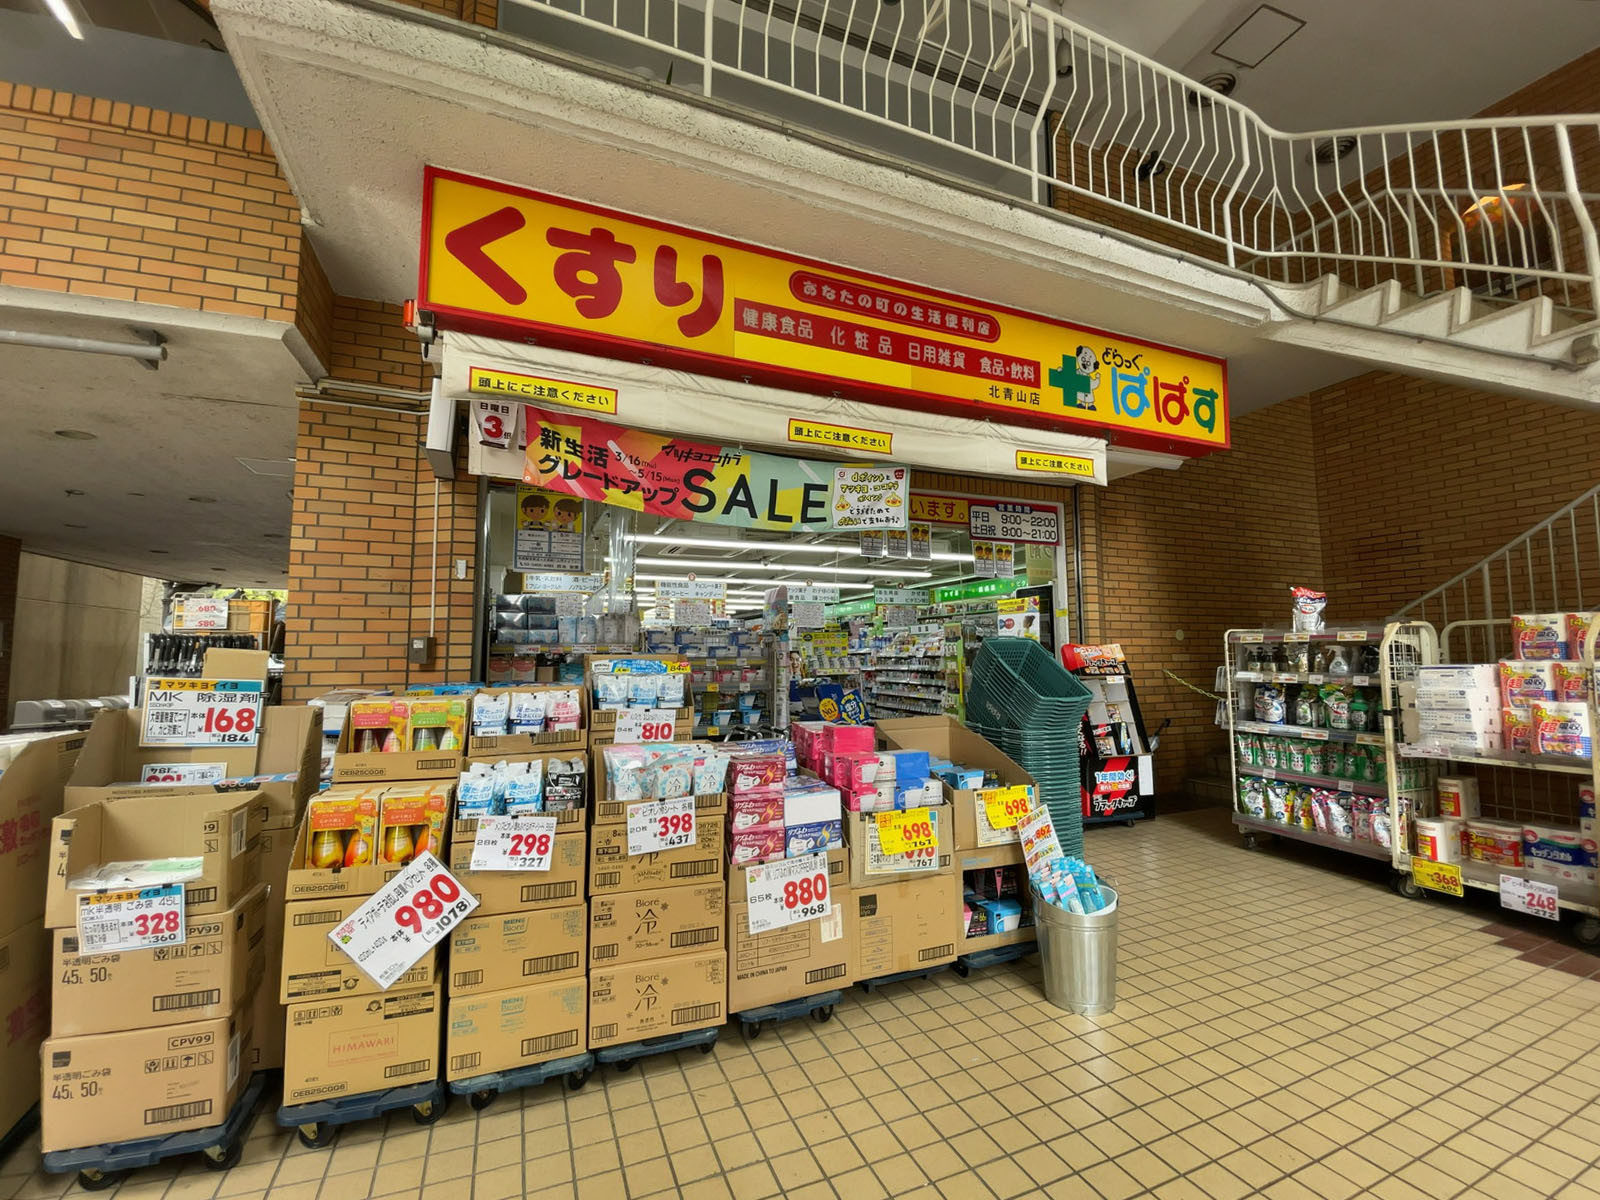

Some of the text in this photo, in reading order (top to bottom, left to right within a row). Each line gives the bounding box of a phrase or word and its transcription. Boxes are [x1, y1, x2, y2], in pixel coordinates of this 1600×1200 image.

[445, 206, 724, 338] くすり
[802, 280, 991, 337] あなたの町の生活便利店
[742, 307, 1036, 382] 健康食品 化粧品 日用雑貨 食品・飲料
[1101, 347, 1144, 370] どらっぐ
[478, 376, 610, 406] 頭上にご注意ください
[988, 385, 1041, 406] 北青山店
[1111, 366, 1219, 434] ぱぱす
[480, 402, 510, 415] 日曜日
[793, 426, 887, 449] 頭上にご注意ください
[540, 426, 610, 469] 新生活
[1020, 456, 1091, 472] 頭上にご注意ください
[538, 454, 680, 505] グレードアップ
[681, 468, 829, 524] SALE
[971, 510, 1056, 527] 平日 9:00～22:00
[972, 525, 1057, 539] 土日祝 9:00～21:00
[165, 681, 239, 690] マツキヨイイヨ
[149, 691, 258, 704] MK 除湿剤
[204, 707, 256, 733] 168
[221, 734, 249, 743] 184
[642, 722, 672, 740] 810
[668, 778, 681, 793] 冷
[703, 775, 716, 789] 冷
[1005, 798, 1029, 816] 698
[657, 813, 693, 837] 398
[903, 822, 932, 841] 698
[509, 833, 551, 856] 298
[669, 834, 689, 846] 437
[519, 857, 544, 867] 327
[916, 859, 933, 867] 767
[1433, 872, 1459, 887] 368
[94, 889, 161, 902] マツキヨイイヨ
[784, 873, 827, 909] 880
[395, 873, 461, 934] 980
[801, 904, 825, 917] 968
[1526, 892, 1556, 912] 248
[134, 910, 180, 936] 328
[436, 900, 468, 931] 1078
[634, 908, 661, 935] 冷
[151, 933, 177, 943] 360
[62, 954, 121, 966] 半透明ごみ袋
[737, 973, 749, 981] MADE
[755, 969, 769, 977] CHINA
[634, 983, 660, 1012] 冷
[170, 1034, 212, 1048] CPV99
[332, 1036, 394, 1054] HIMAWARI
[52, 1068, 112, 1081] 半透明ごみ袋
